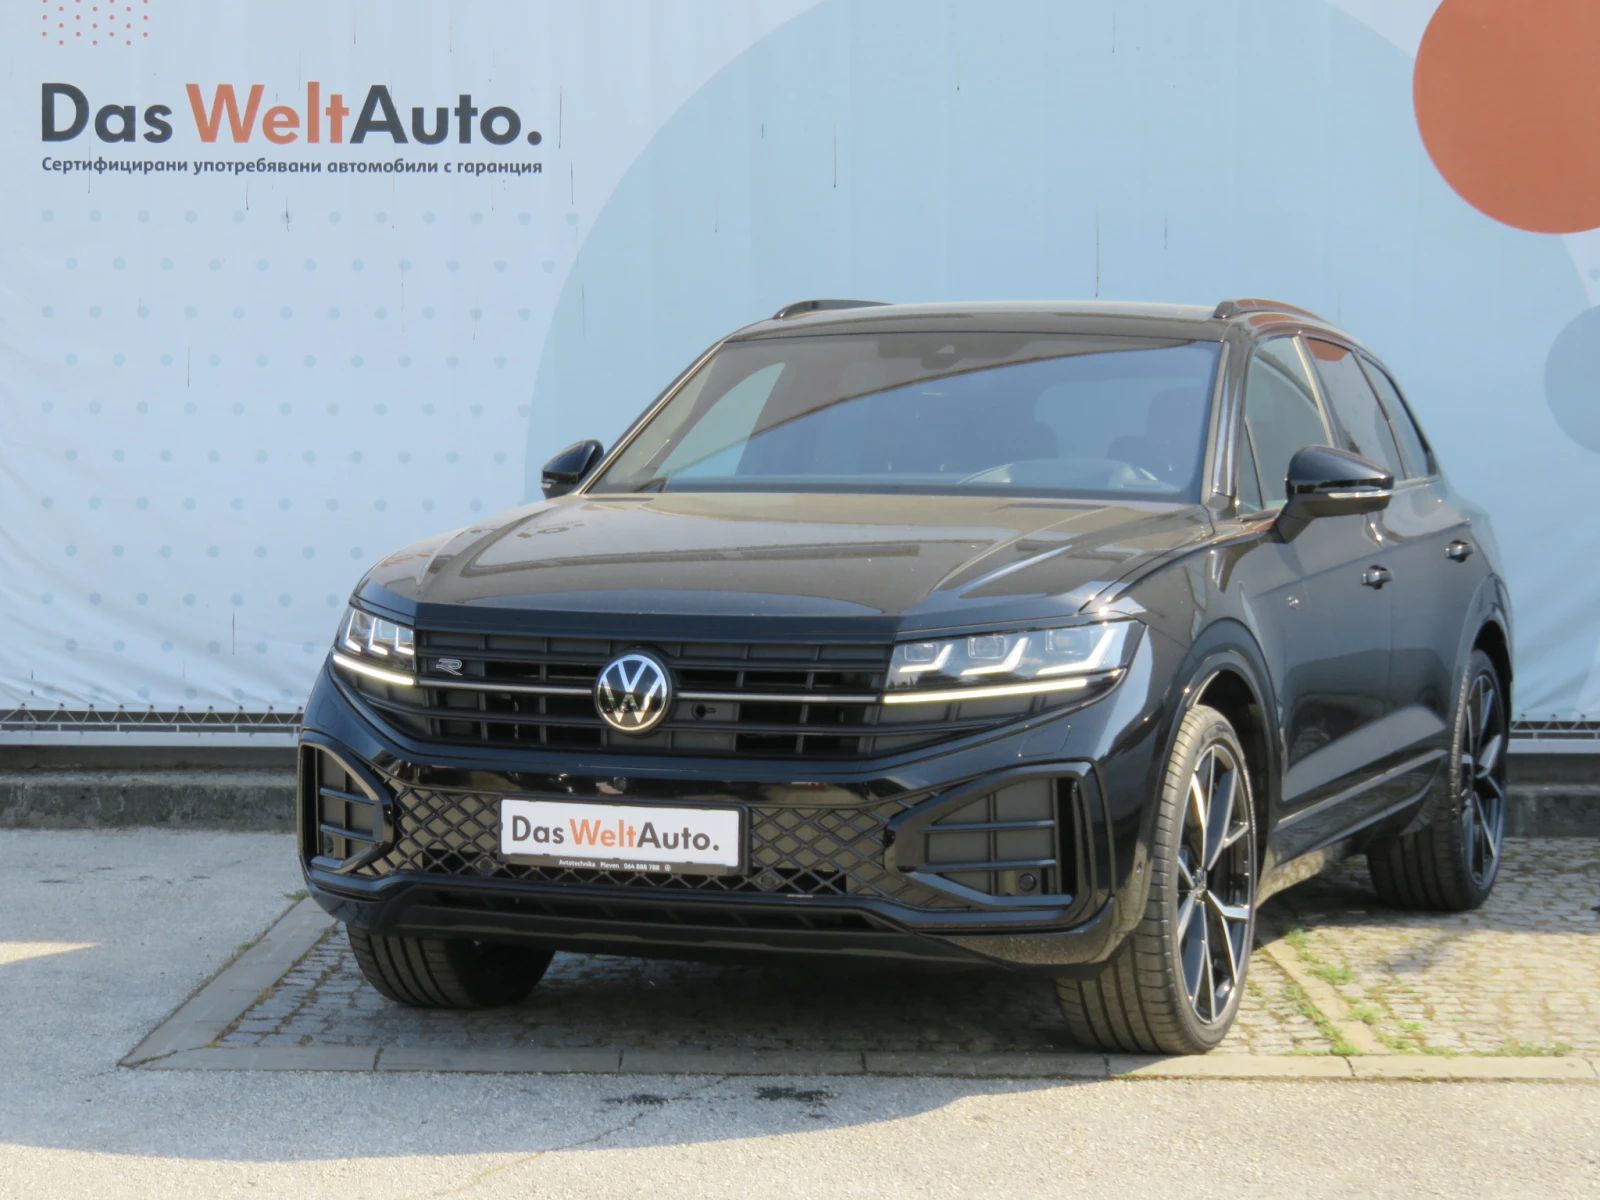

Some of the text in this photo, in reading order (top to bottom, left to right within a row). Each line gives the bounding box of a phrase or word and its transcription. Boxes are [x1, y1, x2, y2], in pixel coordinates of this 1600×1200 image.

[41, 81, 543, 146] Das WeltAuto.
[41, 155, 543, 177] Сертифицирани употребявани автомобили с гаранция
[511, 814, 720, 852] Das WeltAuto.
[600, 861, 620, 869] Pleven
